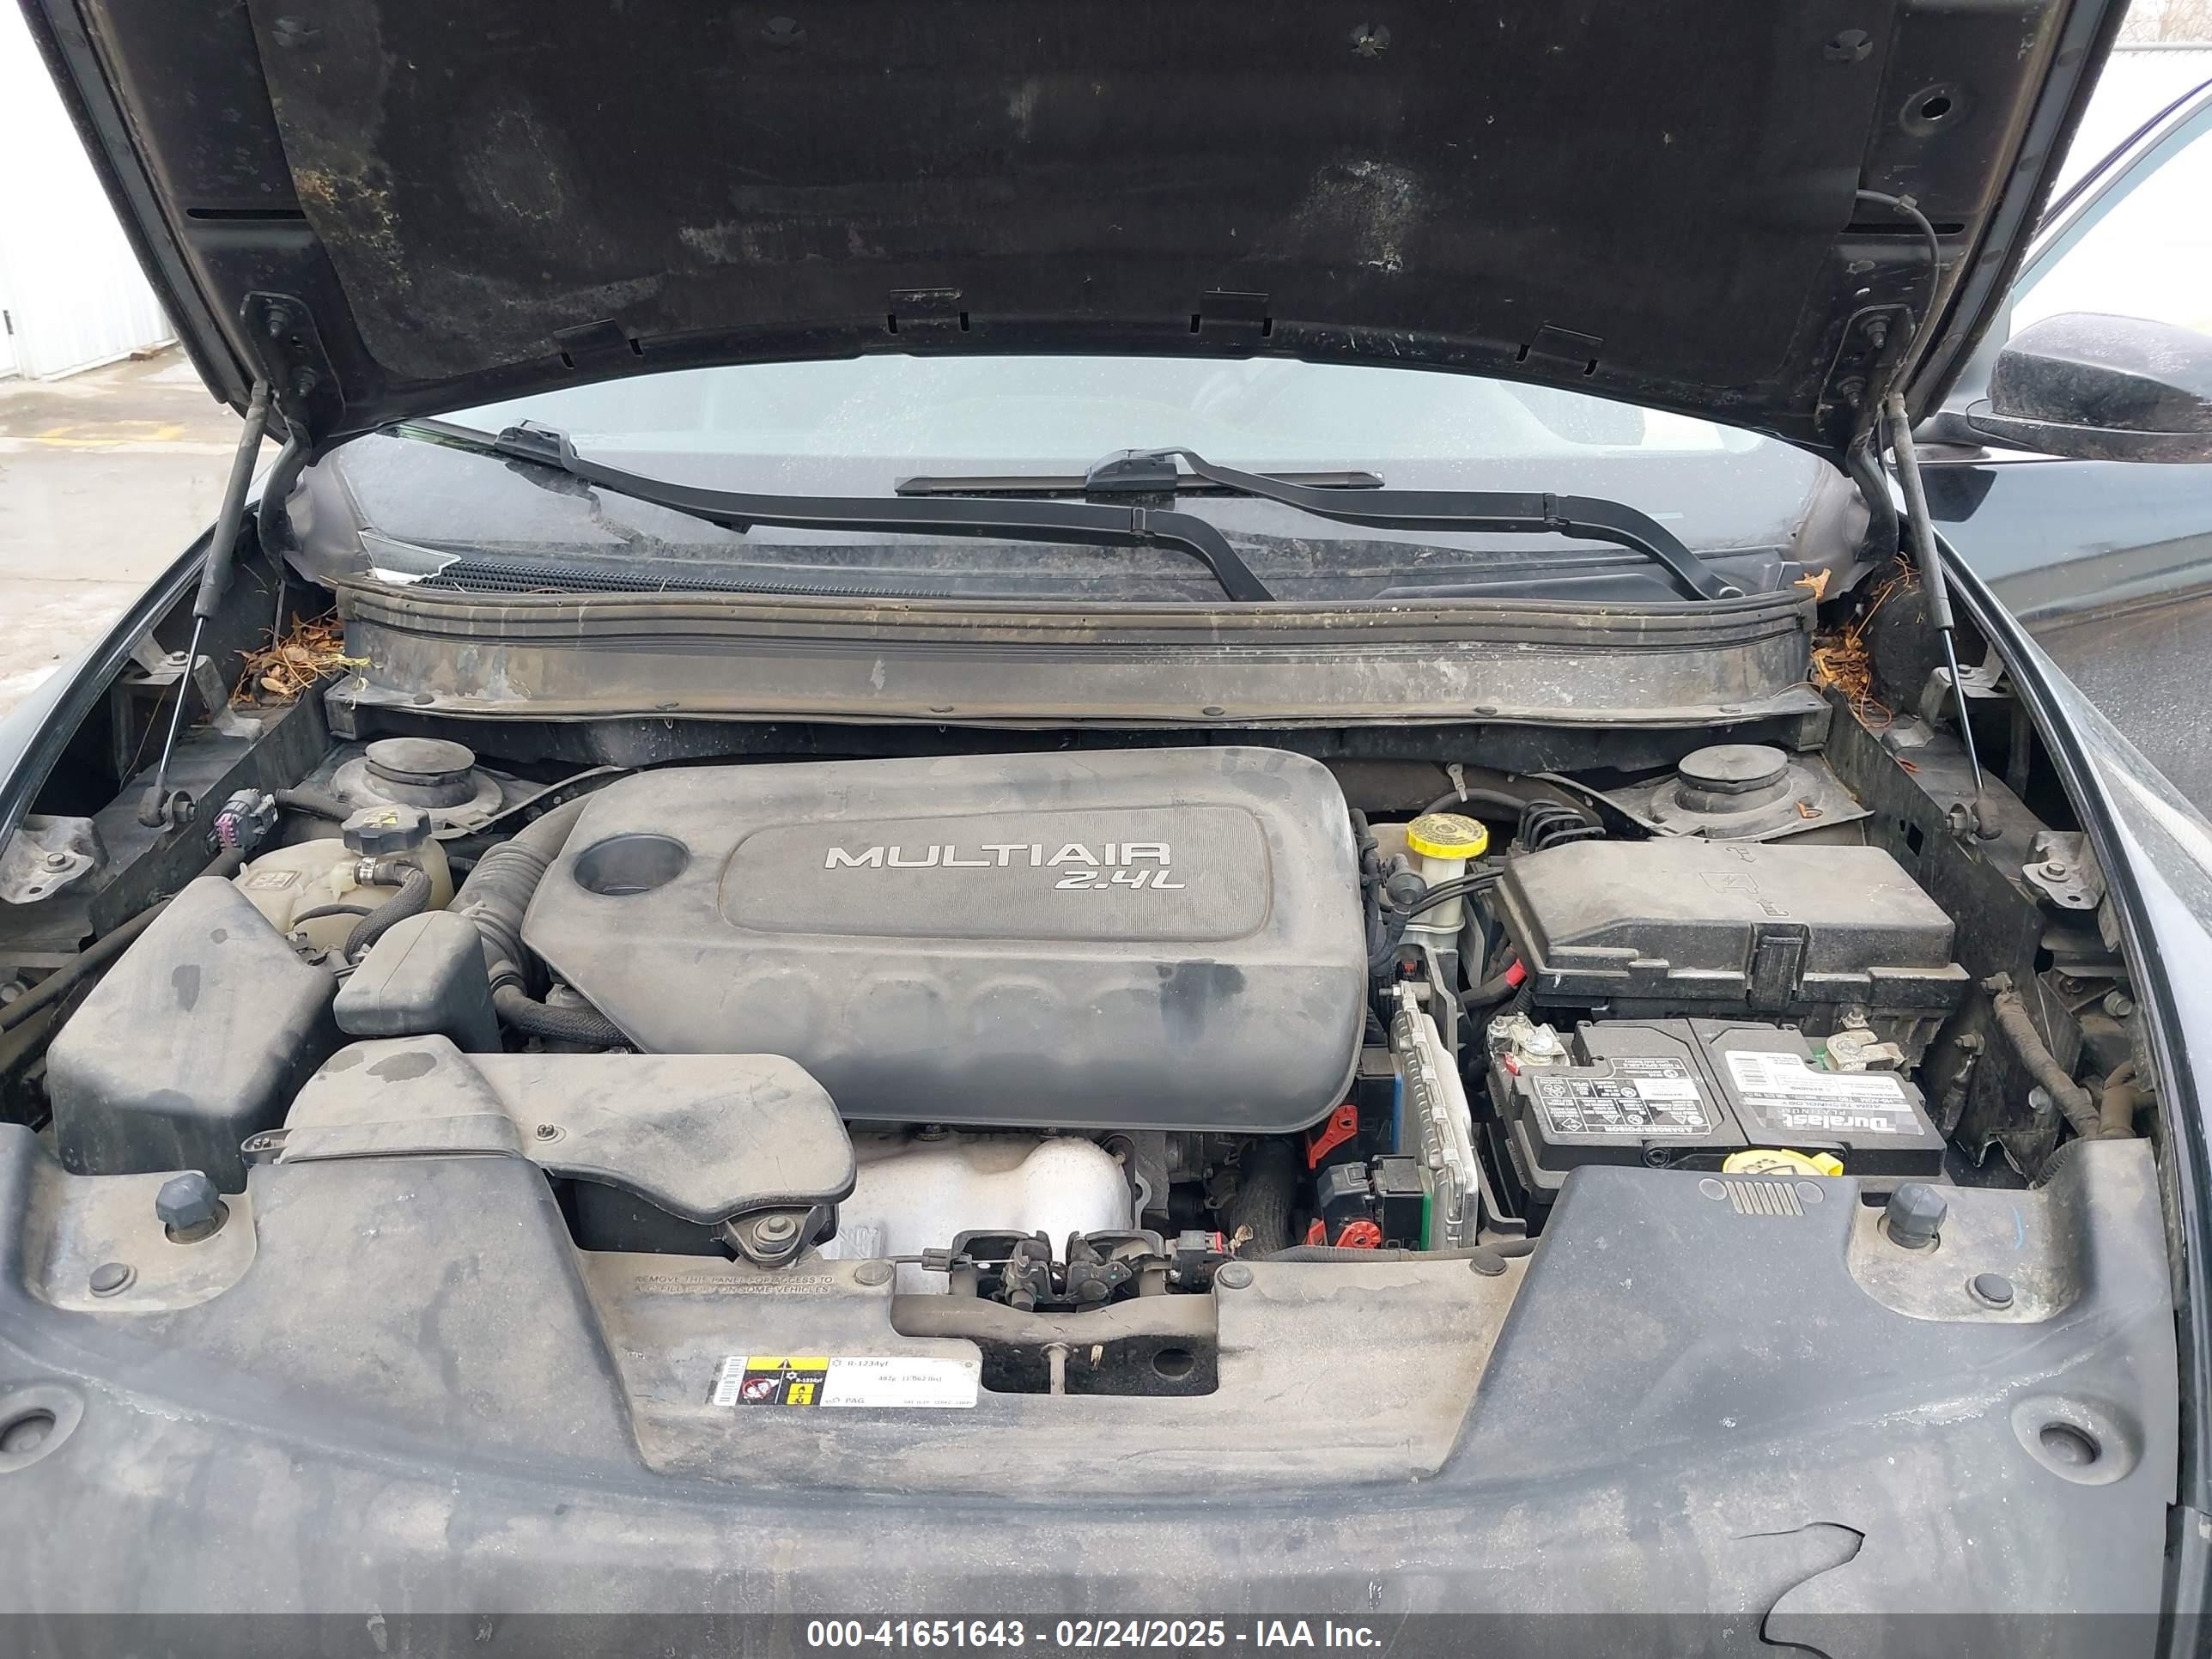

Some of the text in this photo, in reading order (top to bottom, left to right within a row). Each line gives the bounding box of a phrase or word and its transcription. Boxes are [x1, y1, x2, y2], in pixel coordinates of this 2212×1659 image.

[824, 842, 1171, 870] MULTIAIR
[1054, 870, 1187, 890] 2.4L
[1783, 1113, 1896, 1132] Duralast
